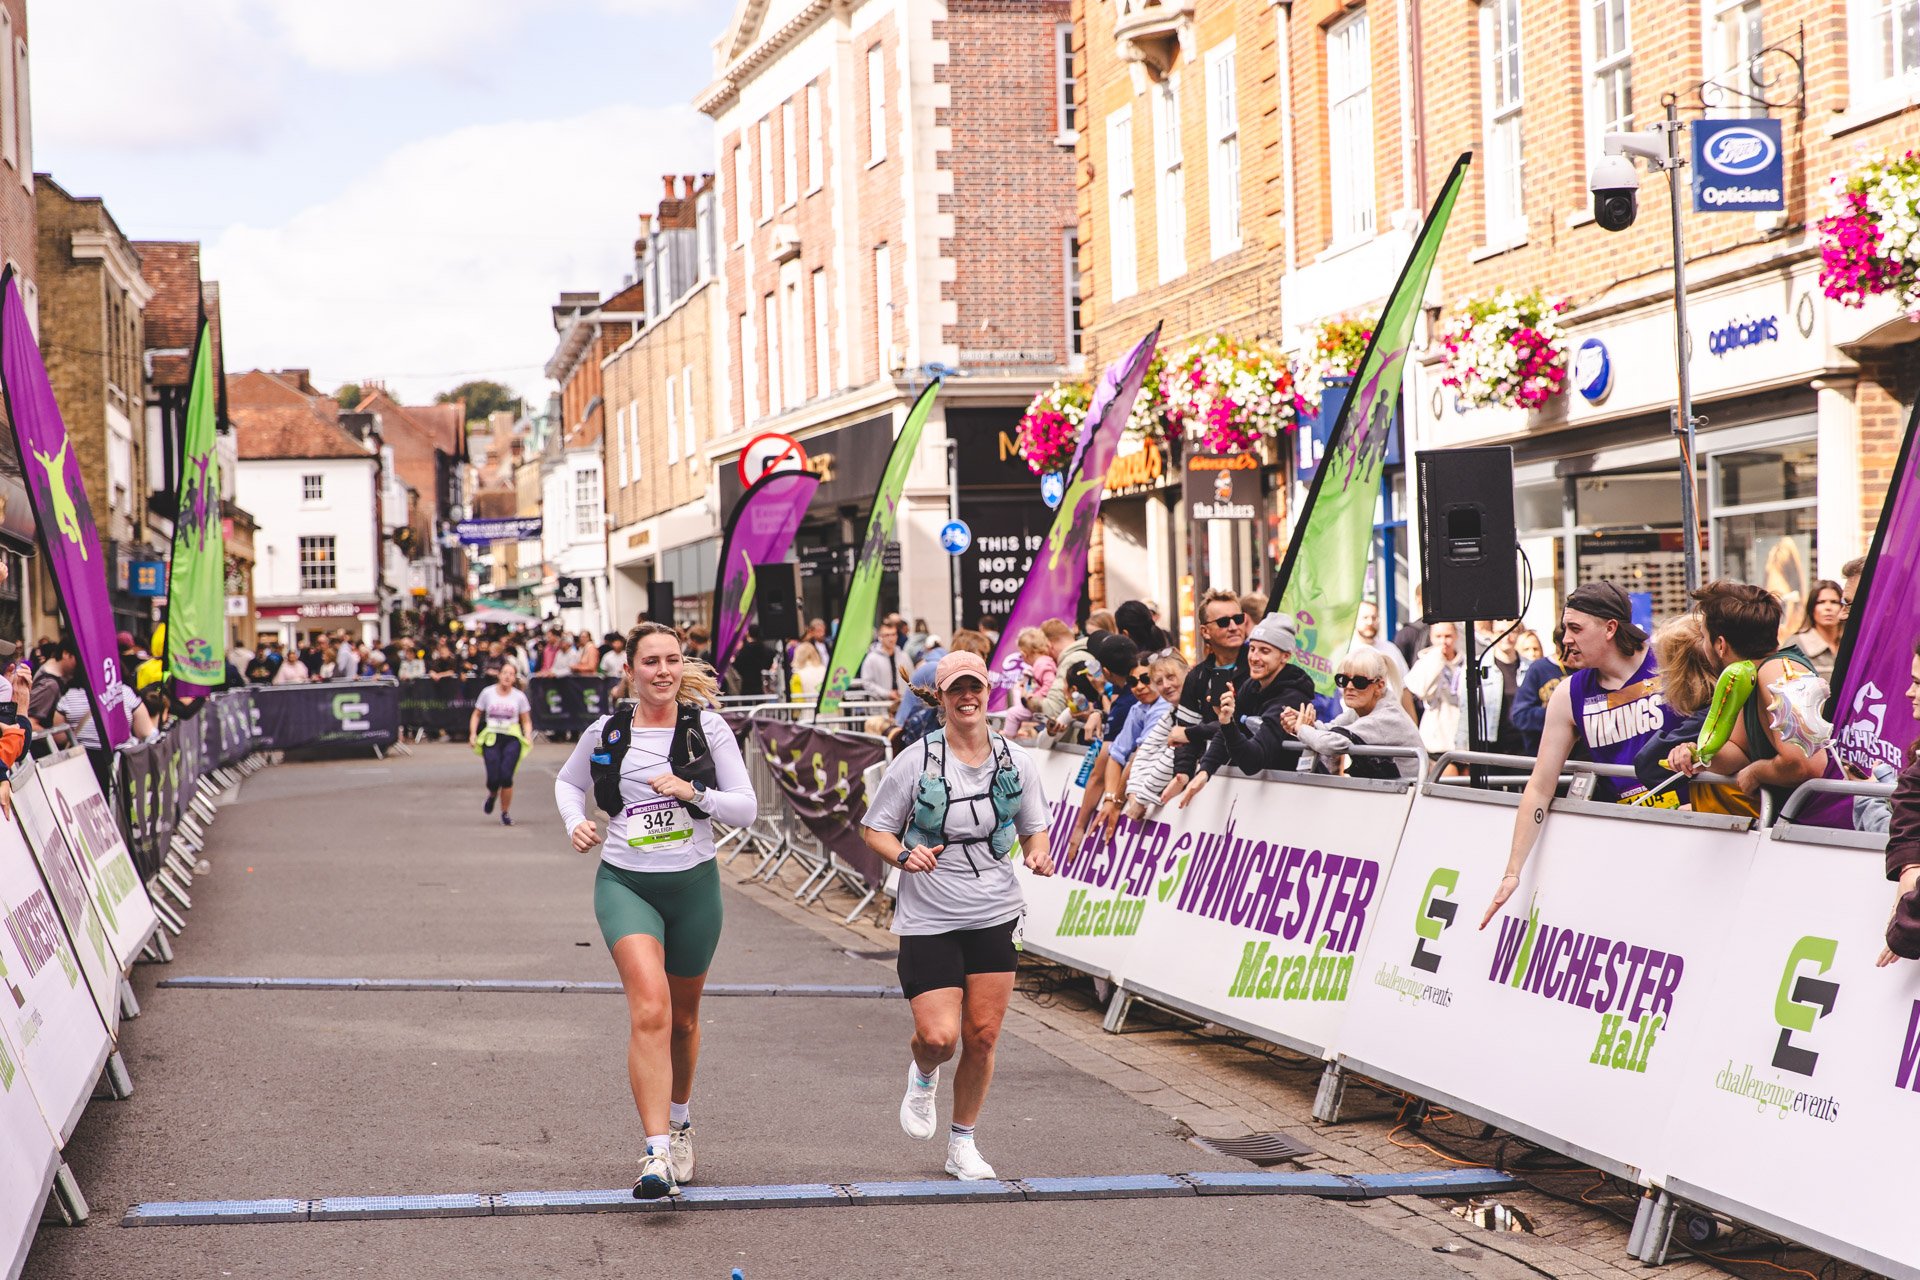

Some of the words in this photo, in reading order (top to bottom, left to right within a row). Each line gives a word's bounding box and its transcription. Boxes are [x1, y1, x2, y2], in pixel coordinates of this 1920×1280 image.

[1702, 186, 1780, 206] Opticians
[1708, 314, 1779, 358] opticians
[998, 430, 1026, 462] M
[977, 536, 1020, 552] THIS
[1025, 535, 1043, 551] IS
[978, 557, 1017, 573] NOT
[1021, 556, 1033, 572] J
[980, 599, 1014, 614] THI
[1296, 649, 1333, 674] ESTER
[1583, 694, 1665, 749] VIKINGS
[642, 810, 675, 830] 342
[648, 826, 673, 835] ASHLEIGH
[1177, 815, 1380, 954] WINCHESTER
[1055, 882, 1147, 937] Marafun
[1228, 934, 1355, 1002] Marafun
[1488, 904, 1685, 1032] WINCHESTER
[1589, 1013, 1664, 1073] Half
